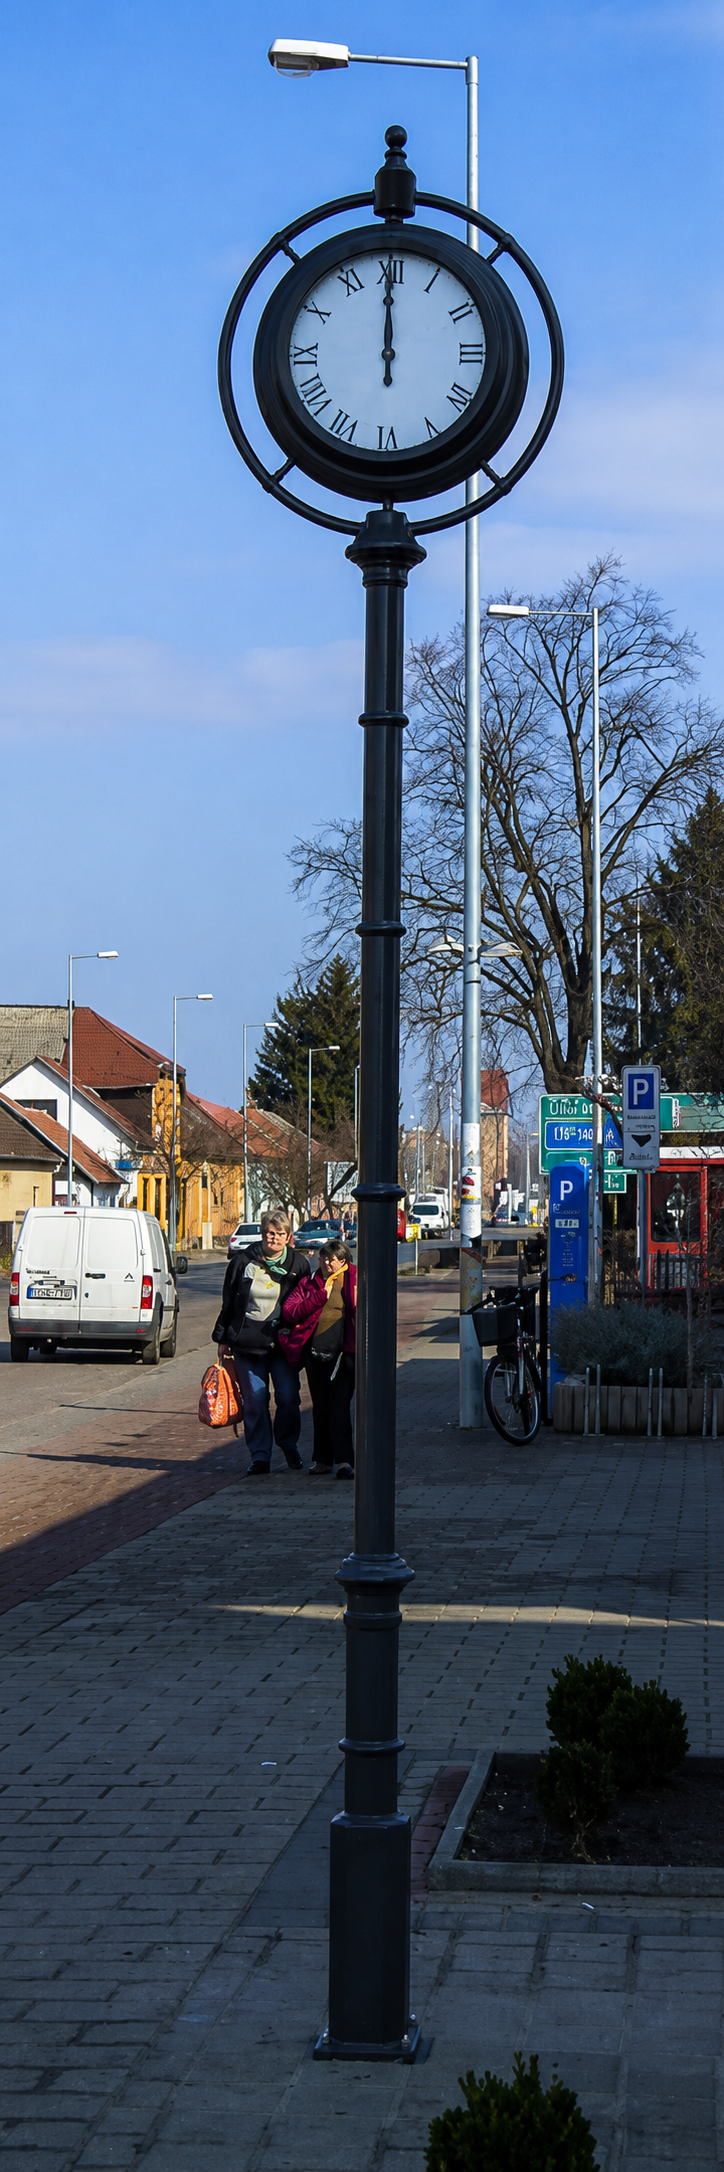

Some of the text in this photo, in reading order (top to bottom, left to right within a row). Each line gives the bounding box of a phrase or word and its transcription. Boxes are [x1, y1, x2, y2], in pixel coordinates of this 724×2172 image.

[337, 268, 365, 297] XI
[376, 260, 405, 284] XII
[424, 271, 441, 294] I
[306, 301, 332, 325] X
[448, 302, 474, 325] II
[293, 342, 319, 367] IX
[459, 342, 484, 366] III
[299, 373, 333, 417] VIII
[446, 382, 474, 414] IV
[328, 408, 359, 443] VII
[376, 425, 399, 450] VI
[424, 416, 441, 439] V
[633, 1078, 650, 1106] P
[560, 1180, 574, 1201] P
